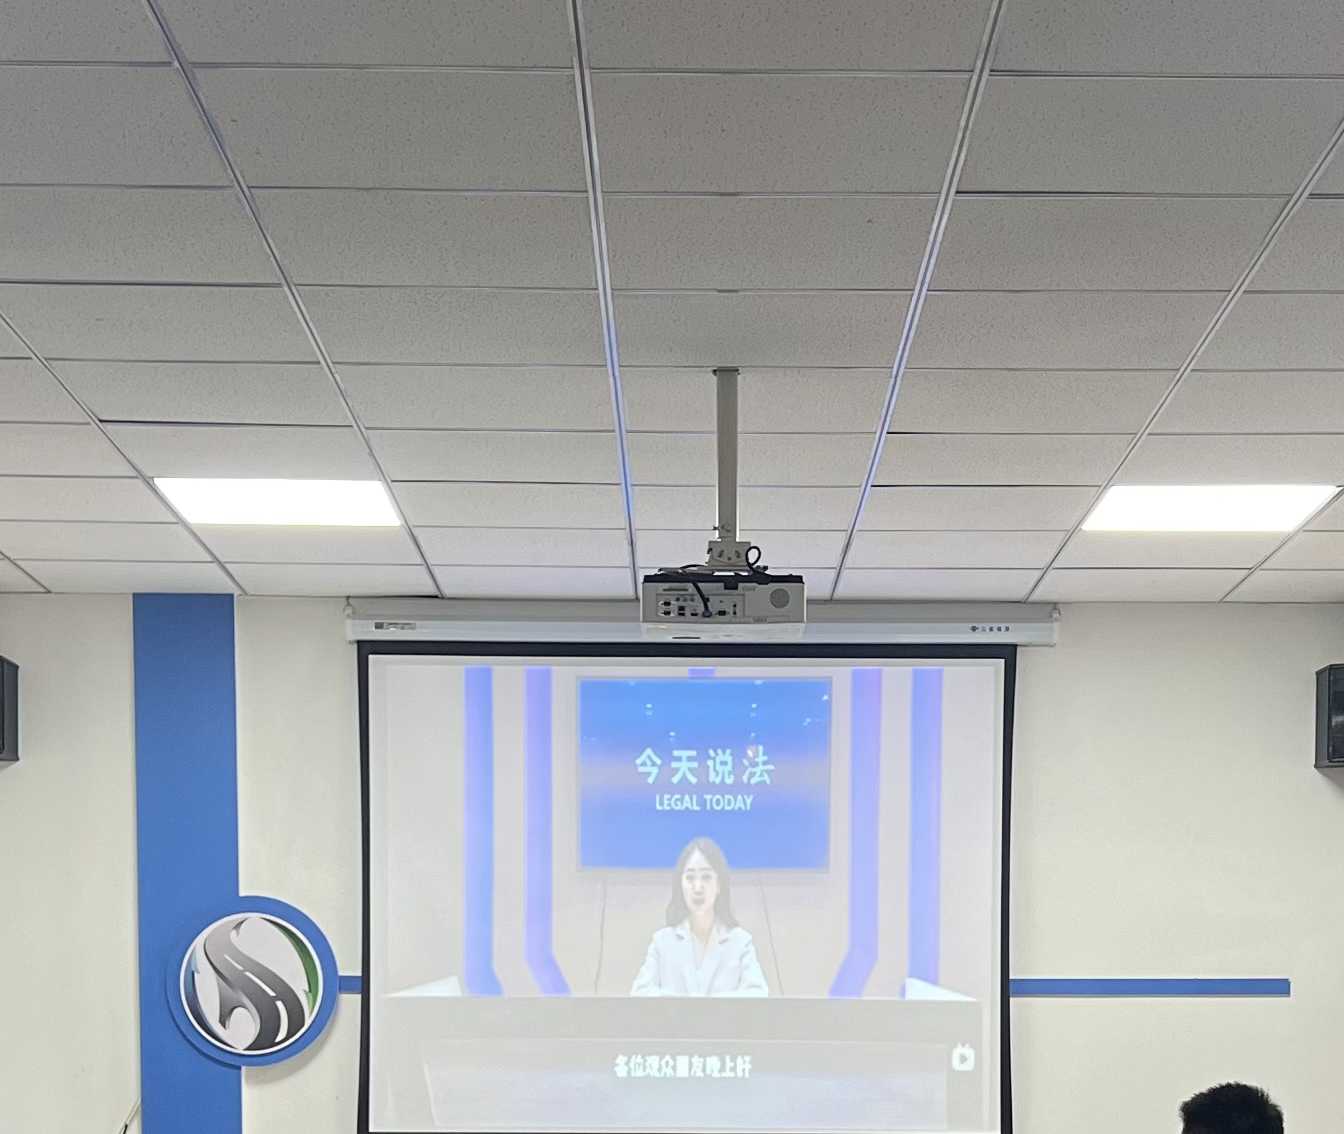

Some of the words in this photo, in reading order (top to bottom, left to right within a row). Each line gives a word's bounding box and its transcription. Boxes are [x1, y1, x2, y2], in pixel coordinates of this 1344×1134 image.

[635, 744, 775, 786] 今天说法
[656, 794, 700, 811] LEGAL
[704, 794, 754, 811] TODAY
